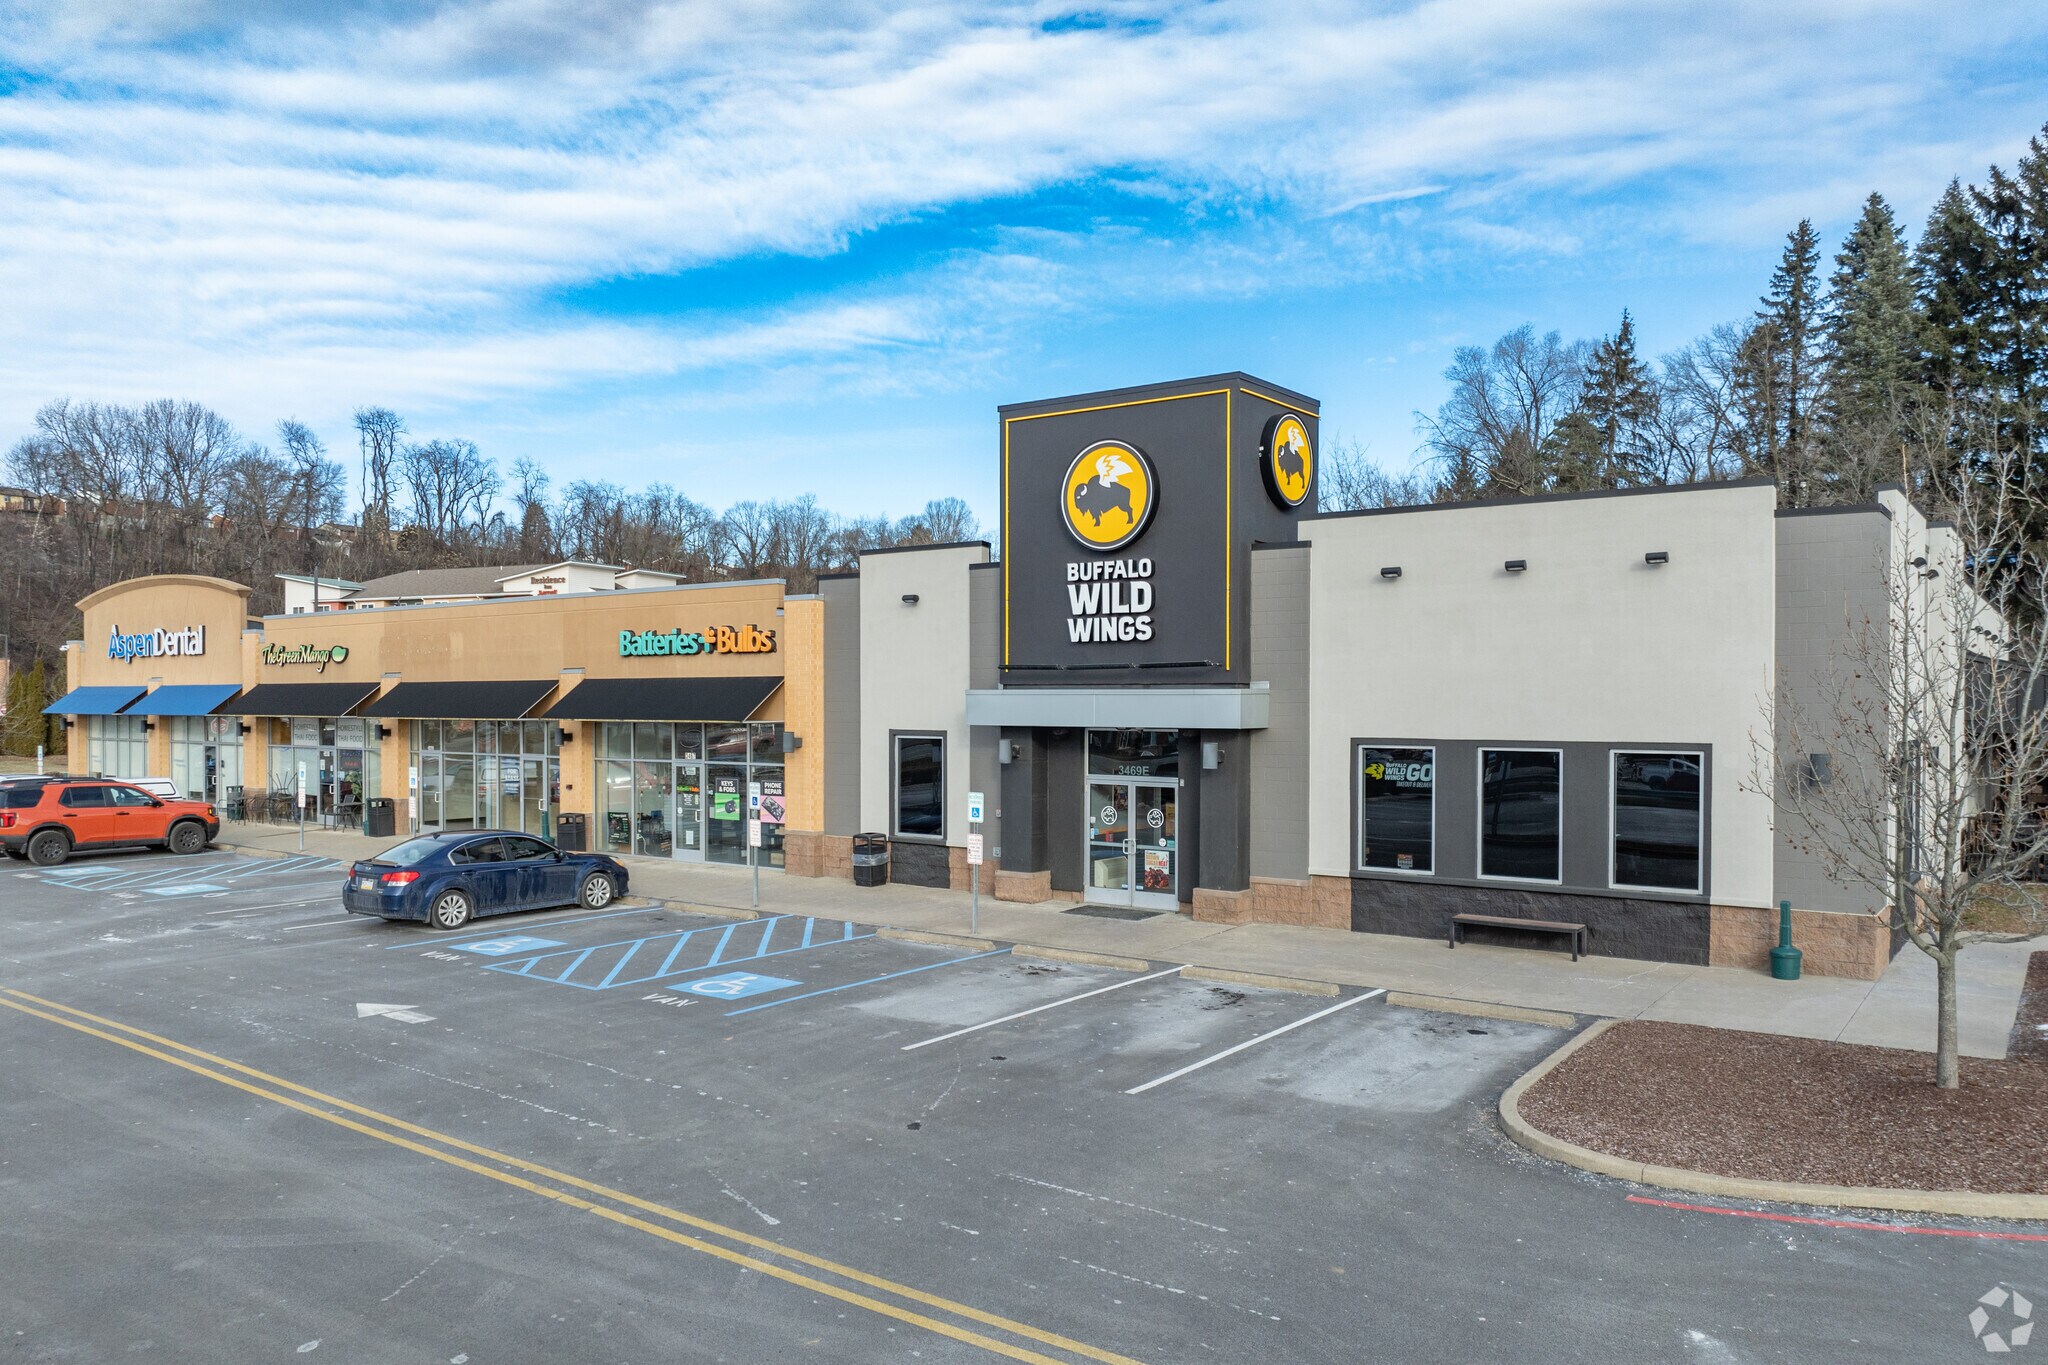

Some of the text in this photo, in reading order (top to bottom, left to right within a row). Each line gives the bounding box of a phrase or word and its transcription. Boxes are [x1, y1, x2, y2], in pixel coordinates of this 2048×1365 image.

[1067, 557, 1153, 581] BUFFALO
[1067, 580, 1154, 615] WILD
[1067, 615, 1154, 643] WINGS
[338, 734, 363, 743] THAI FOOD
[1118, 765, 1150, 776] 3469E
[1385, 767, 1406, 775] WILD
[1406, 763, 1432, 781] GO
